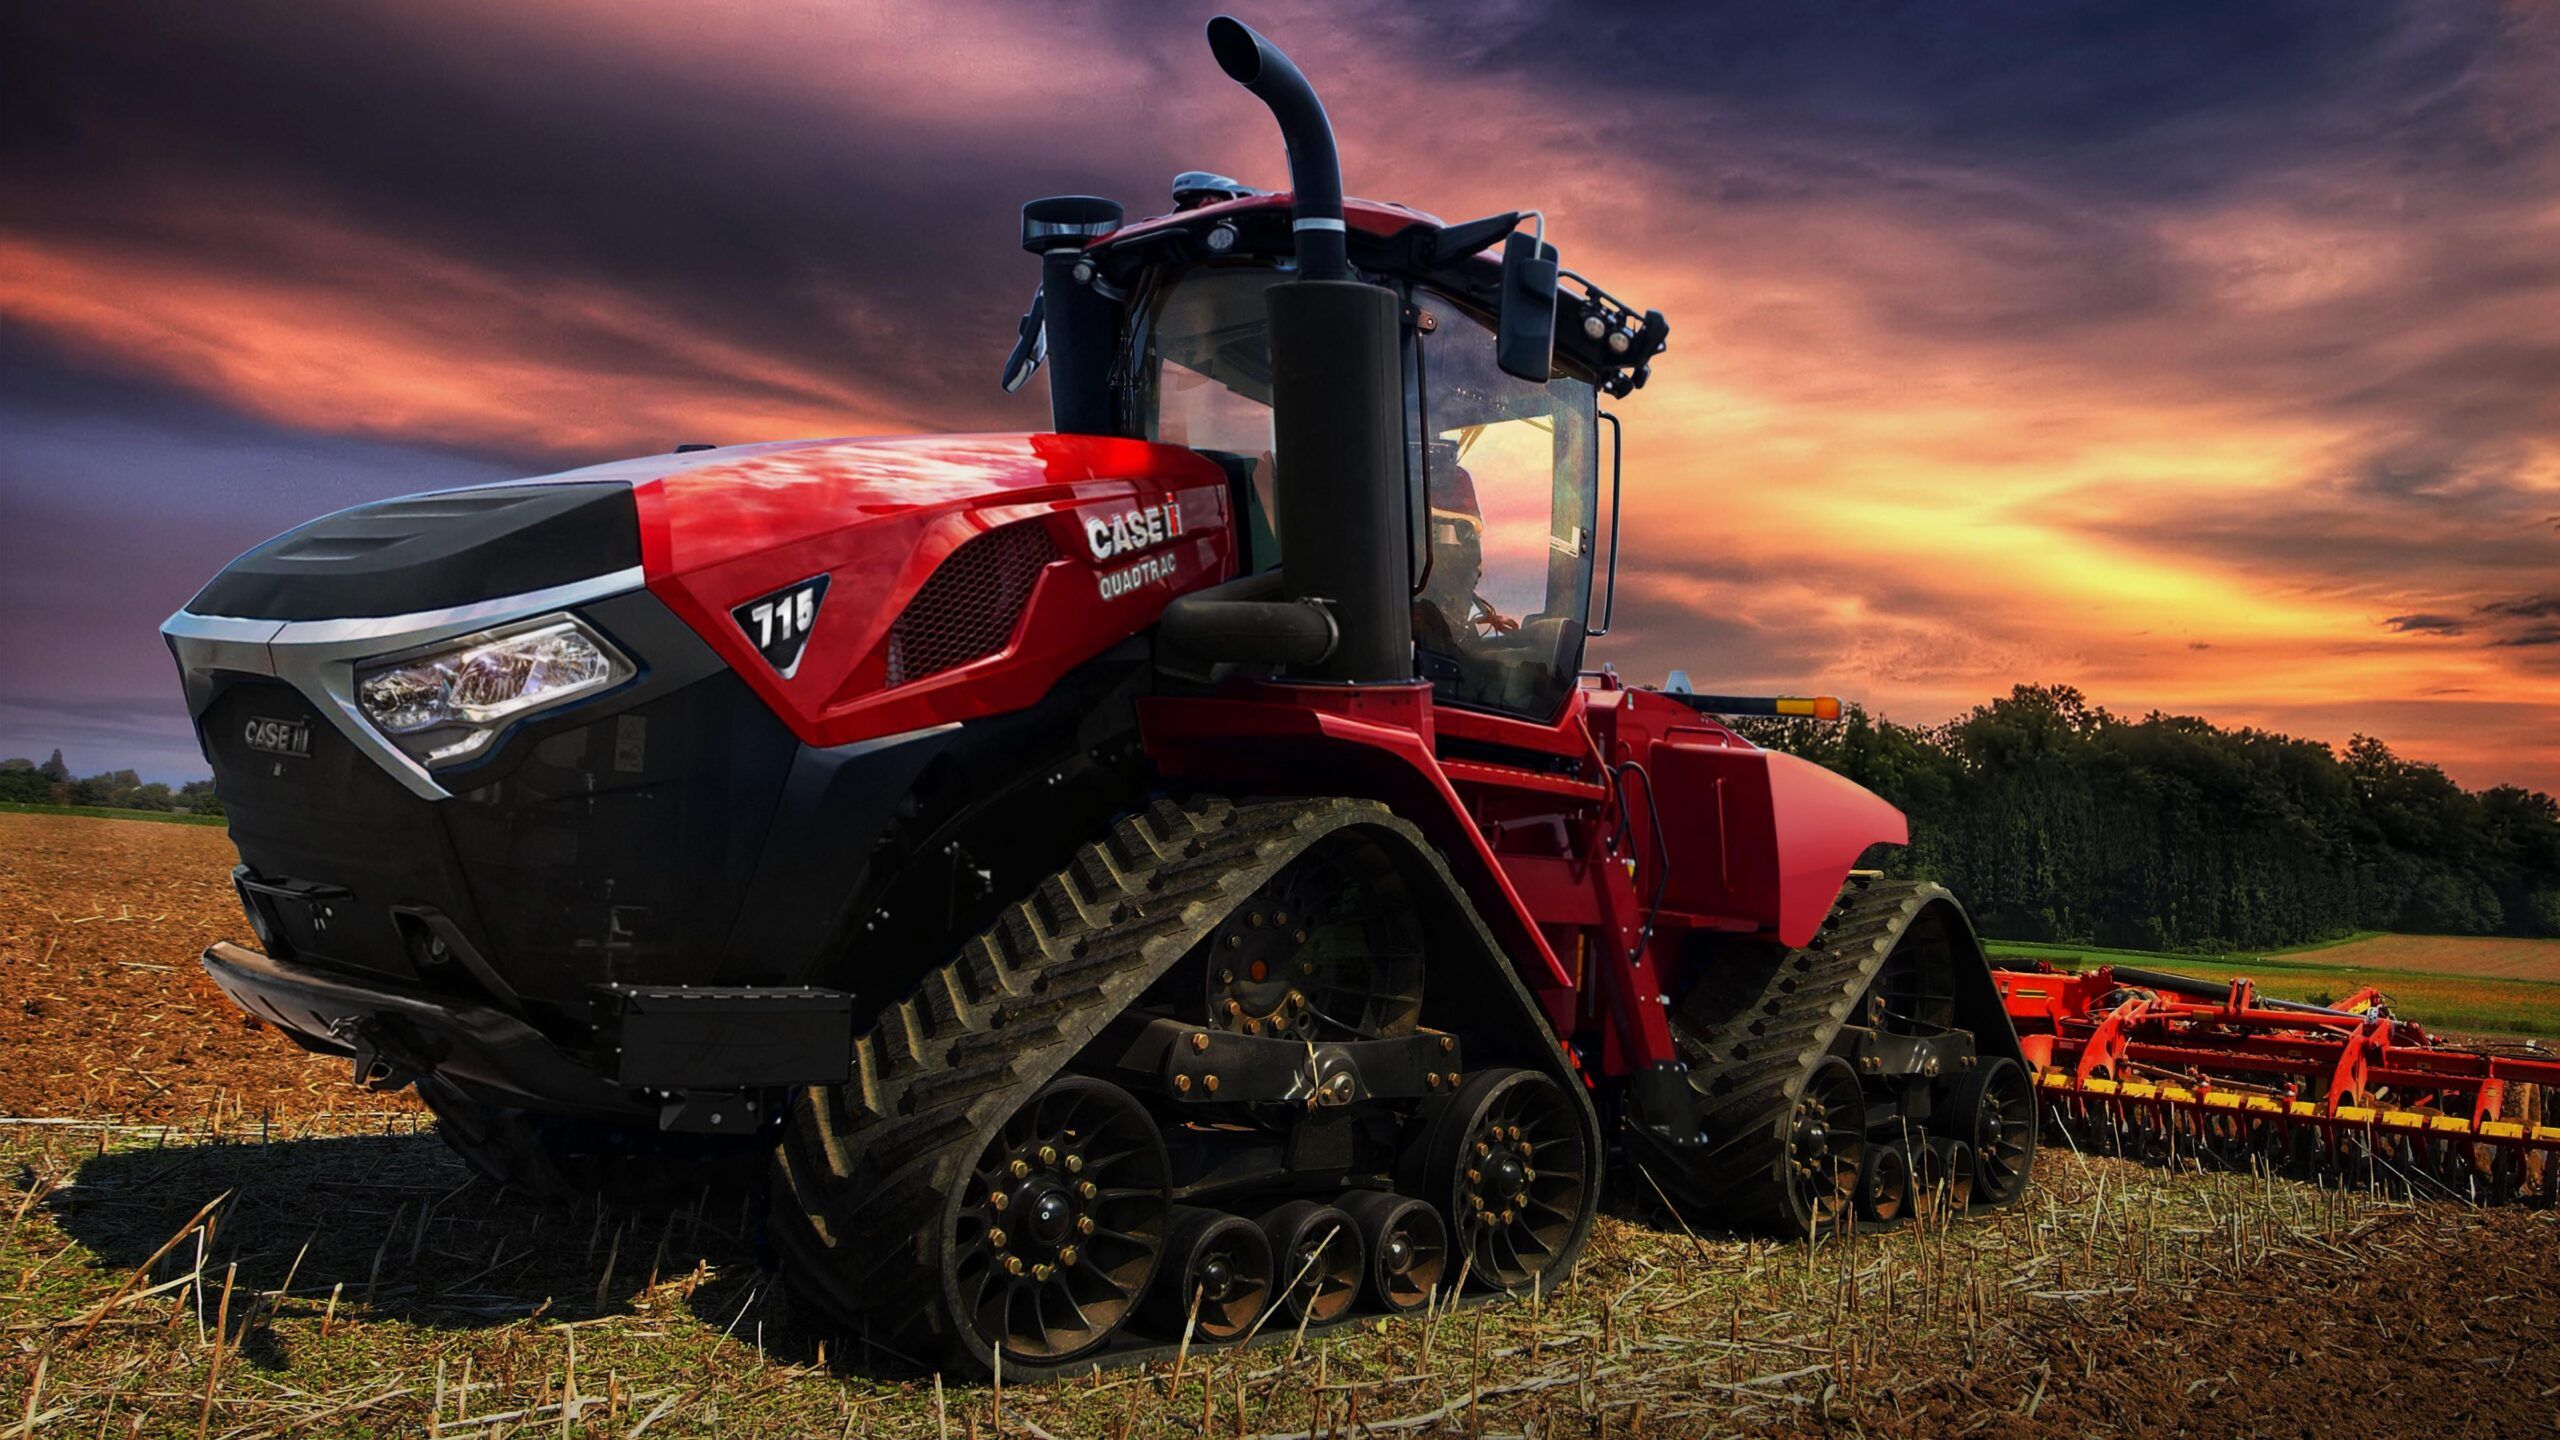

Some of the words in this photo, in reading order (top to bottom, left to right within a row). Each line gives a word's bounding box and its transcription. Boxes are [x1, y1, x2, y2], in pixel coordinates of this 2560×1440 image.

[1086, 506, 1163, 560] CASE
[1100, 553, 1177, 600] QUADTRAC
[751, 587, 814, 650] 715
[245, 720, 290, 751] CASE
